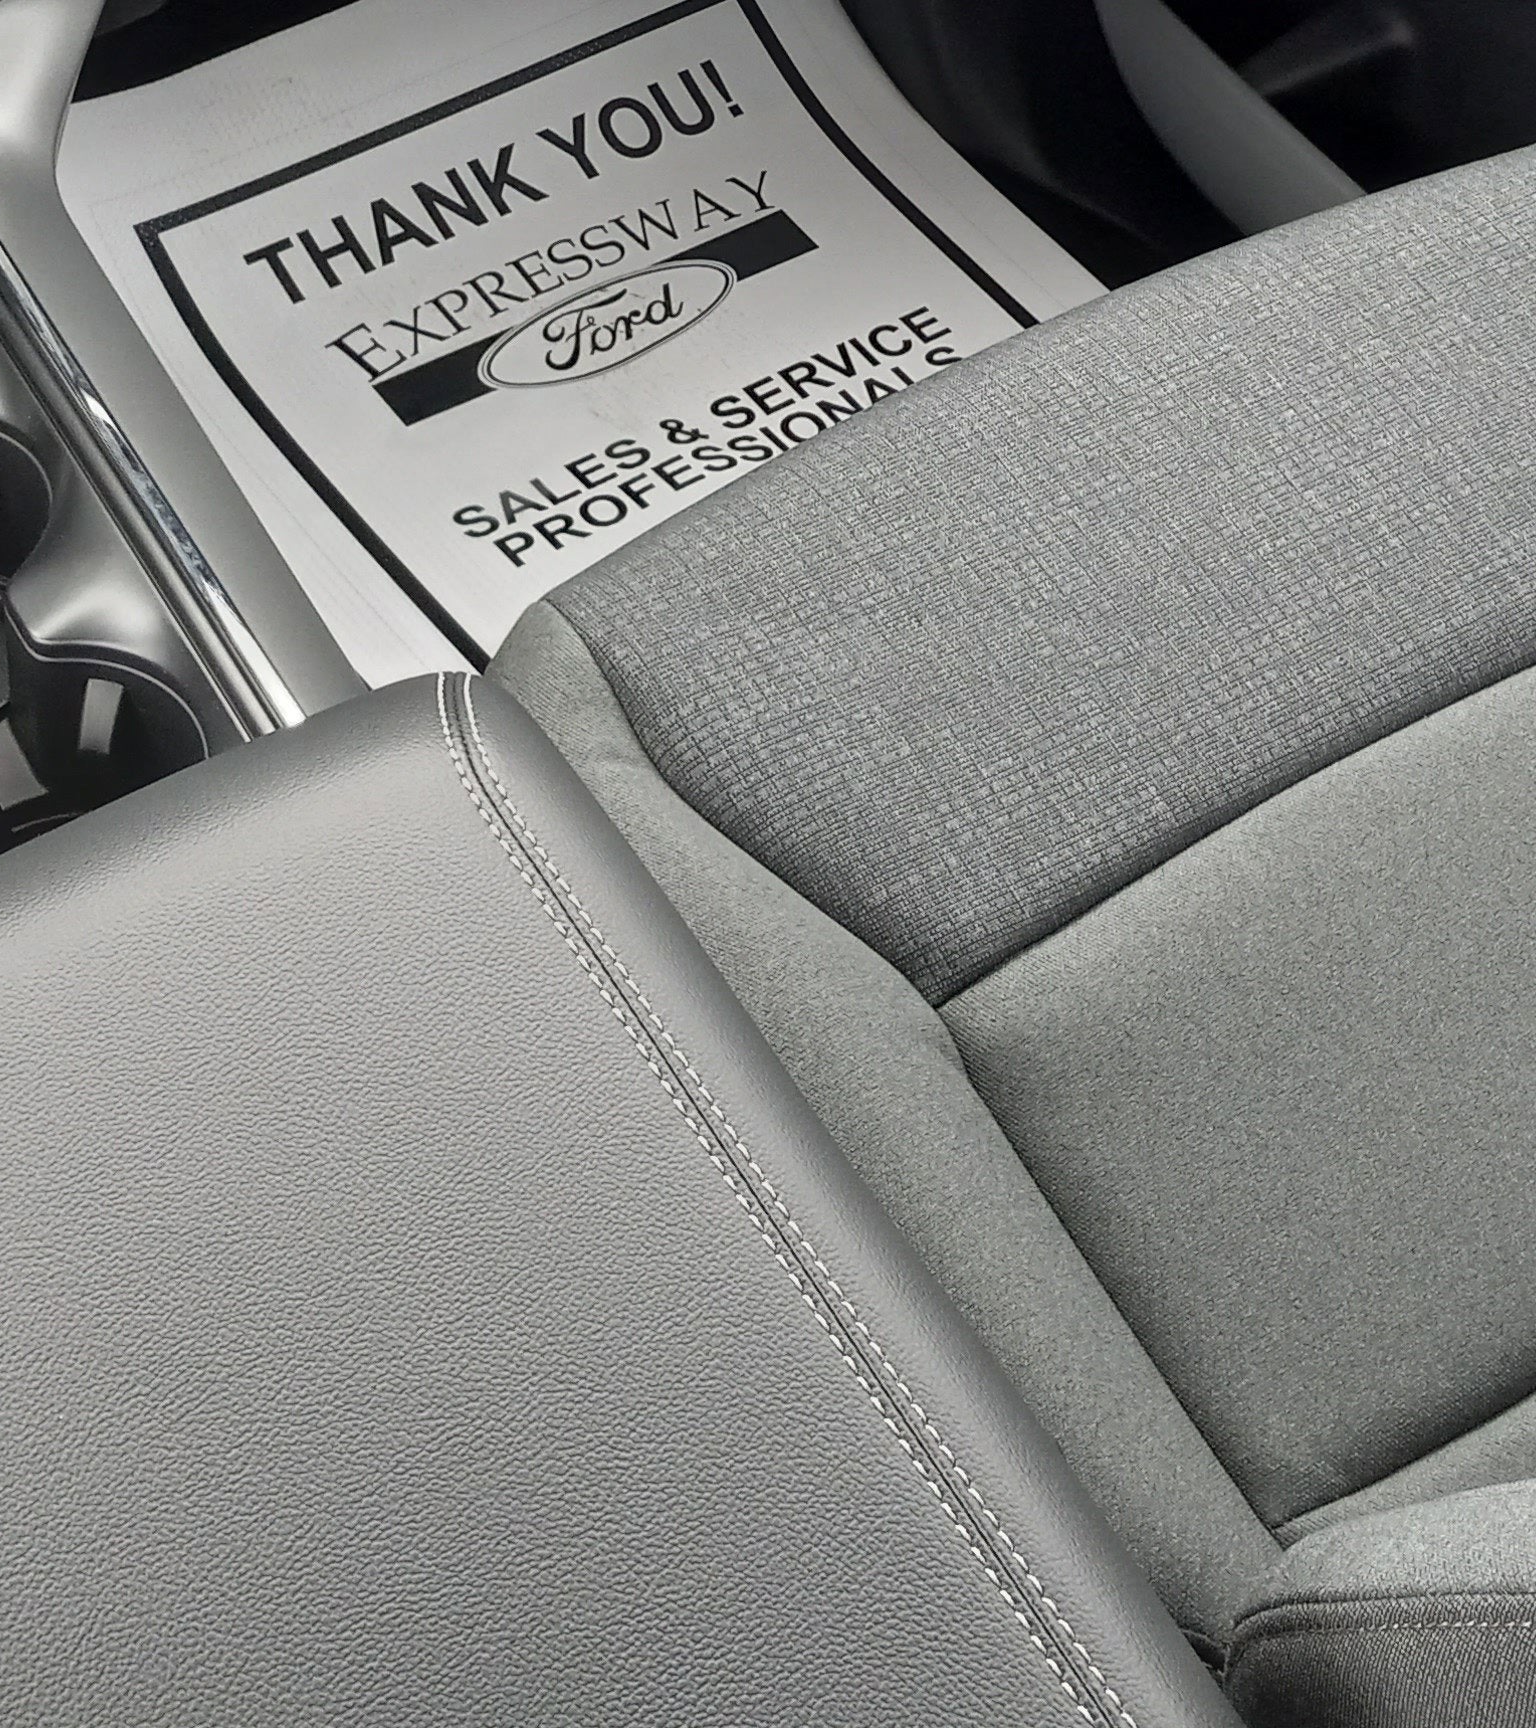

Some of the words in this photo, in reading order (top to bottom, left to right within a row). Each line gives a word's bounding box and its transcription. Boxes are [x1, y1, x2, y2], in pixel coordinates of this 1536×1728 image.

[242, 142, 550, 306] THANK
[535, 58, 746, 184] YOU!
[324, 169, 785, 384] EXPRESSWAY
[452, 439, 652, 538] SALES
[659, 418, 710, 445] &
[709, 305, 953, 429] SERVICE
[541, 282, 685, 374] Ford
